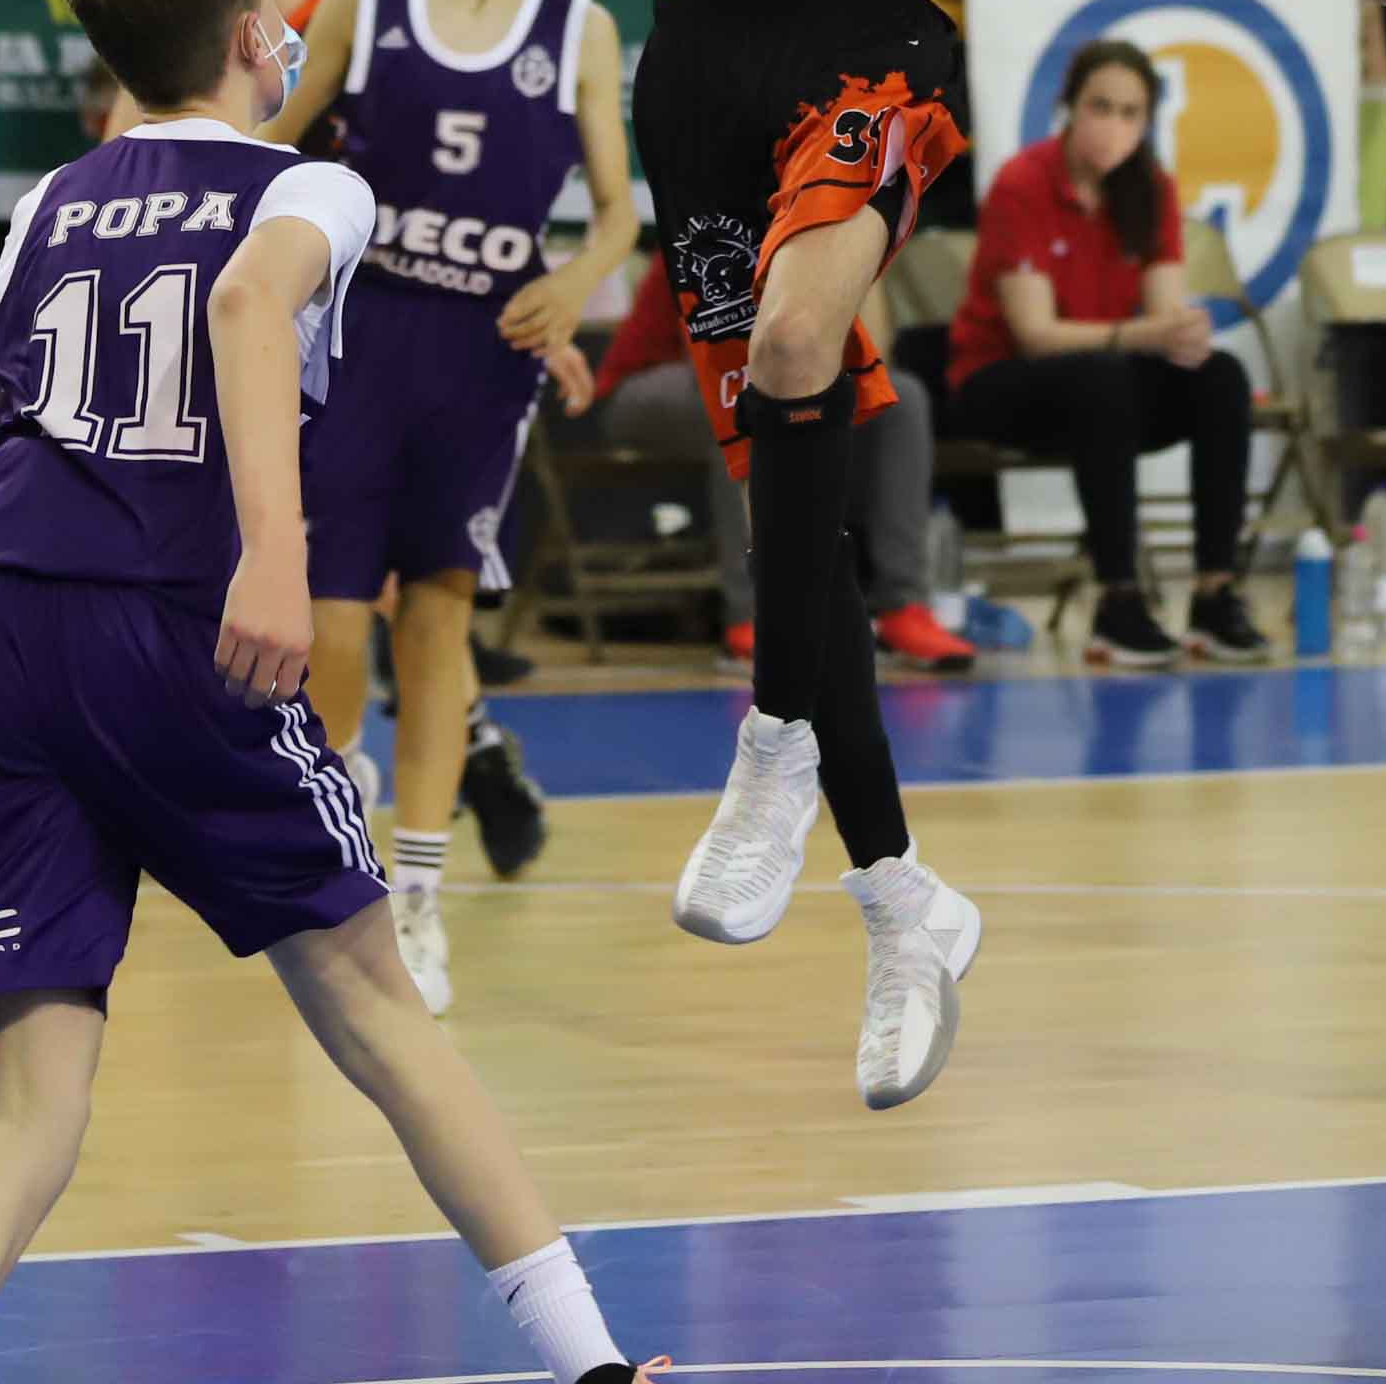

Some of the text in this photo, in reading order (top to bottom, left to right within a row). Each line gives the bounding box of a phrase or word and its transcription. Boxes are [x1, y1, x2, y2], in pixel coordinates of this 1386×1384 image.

[432, 109, 487, 176] 5
[46, 190, 239, 250] POPA
[19, 262, 210, 465] 11
